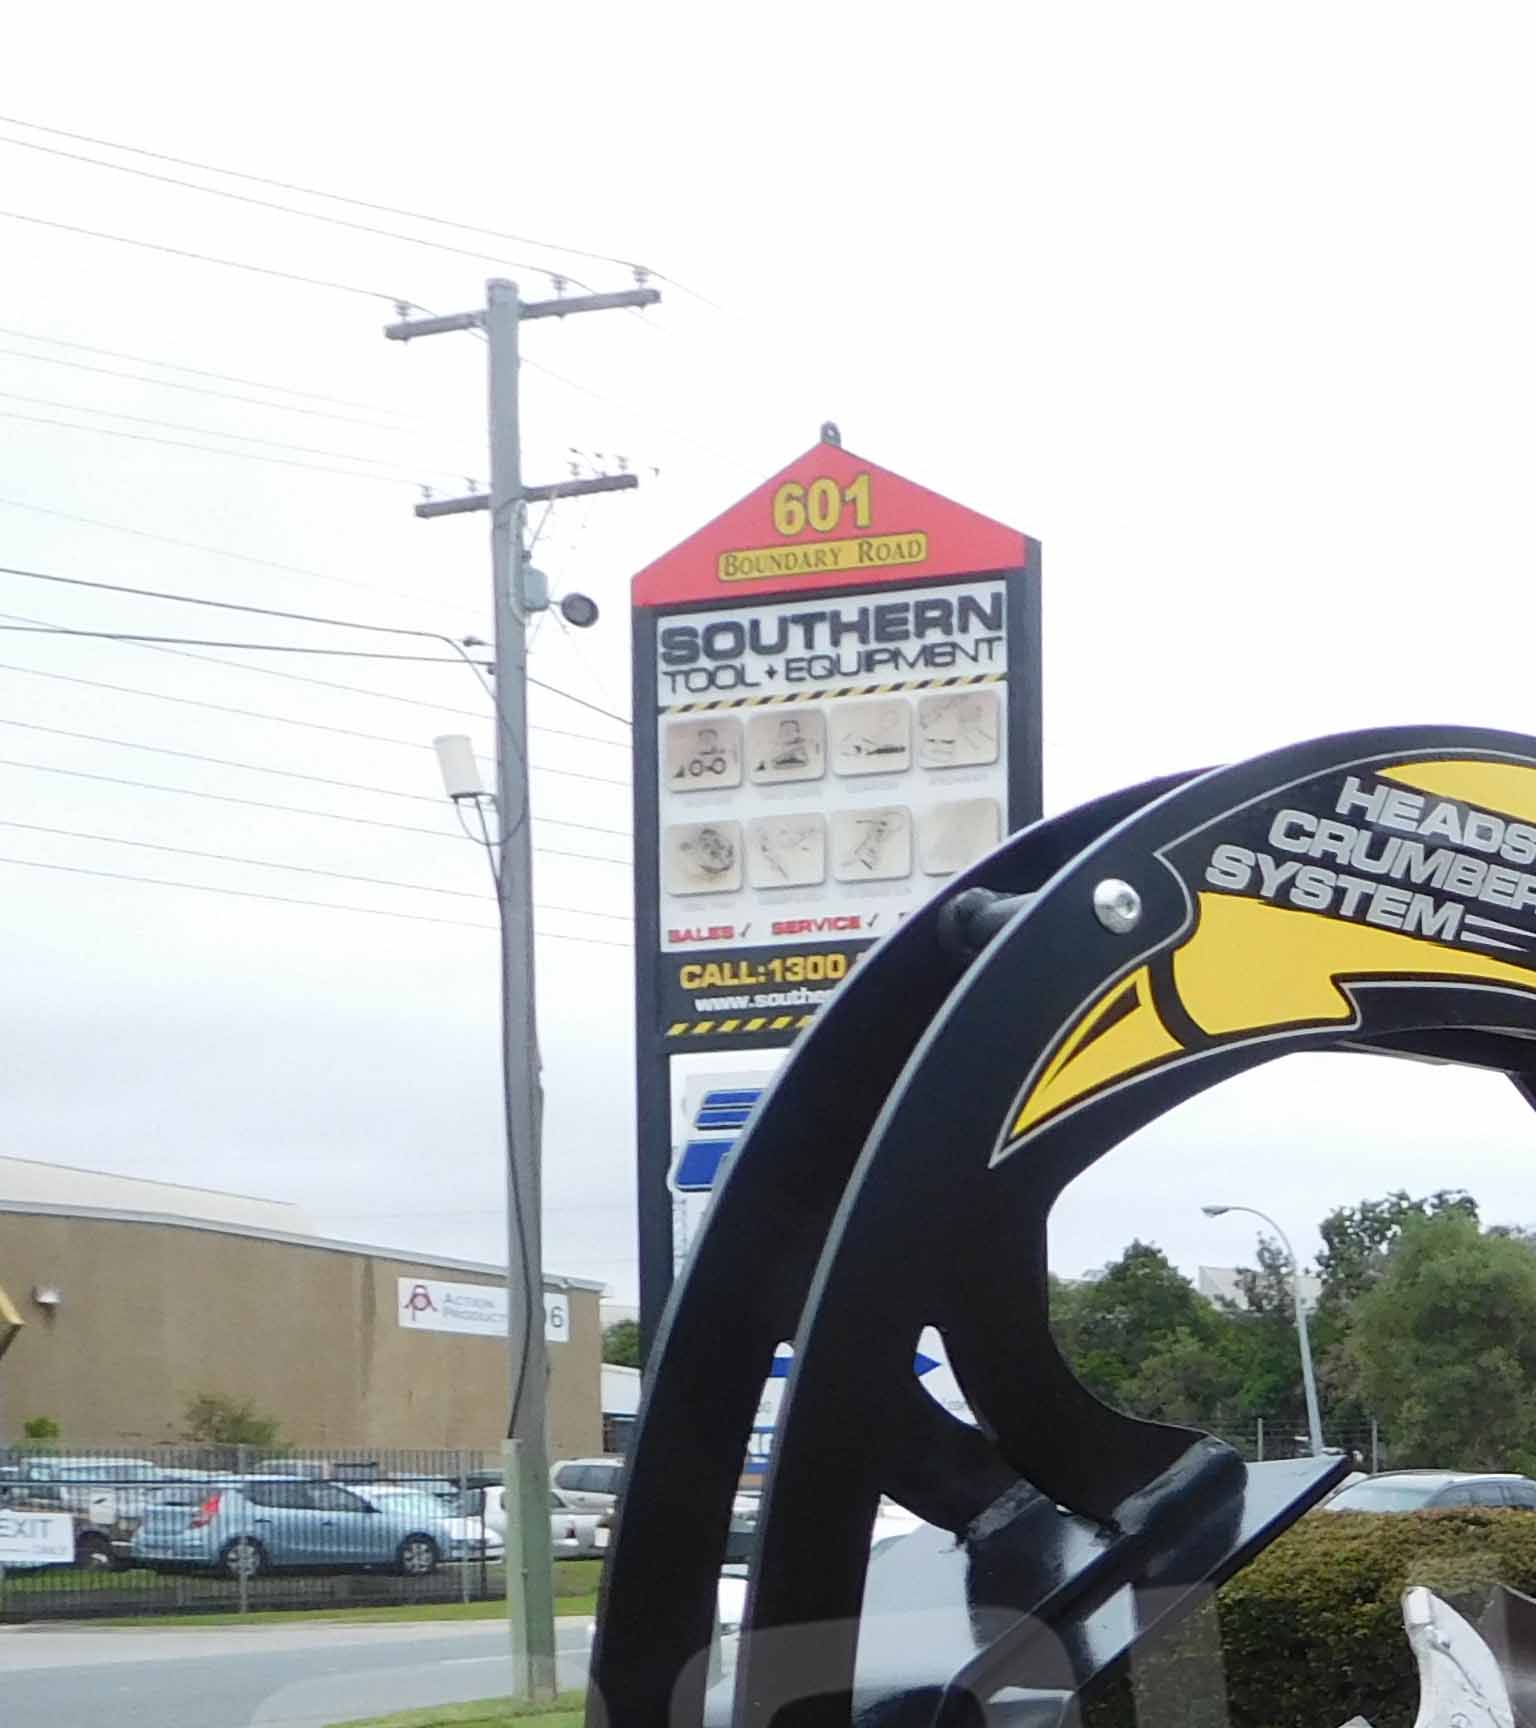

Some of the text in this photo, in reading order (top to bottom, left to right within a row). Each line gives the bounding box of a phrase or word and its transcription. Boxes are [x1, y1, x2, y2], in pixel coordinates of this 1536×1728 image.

[772, 471, 872, 537] 601
[722, 538, 923, 577] BOUNDARY ROAD
[660, 592, 1003, 666] SOUTHERN
[663, 662, 761, 695] TOOL
[785, 637, 1003, 683] EQUIPMENT
[1206, 844, 1466, 943] SYSTEM
[668, 915, 861, 944] SALES SERVICE
